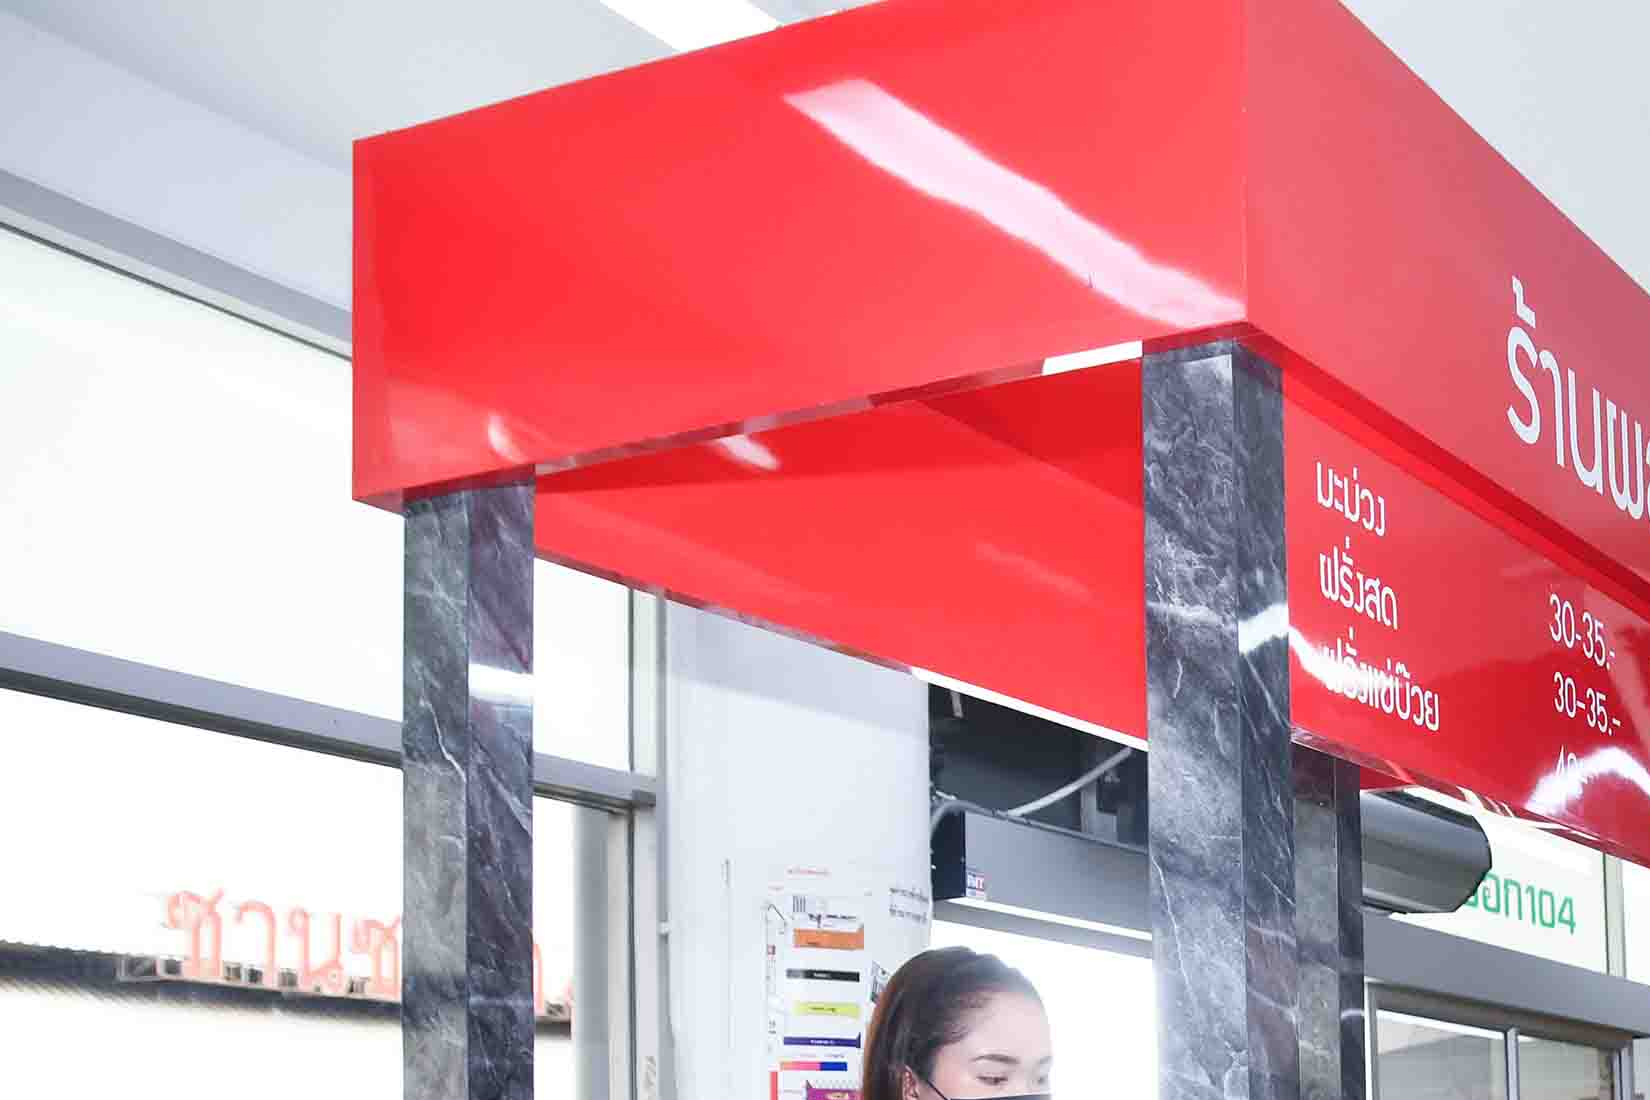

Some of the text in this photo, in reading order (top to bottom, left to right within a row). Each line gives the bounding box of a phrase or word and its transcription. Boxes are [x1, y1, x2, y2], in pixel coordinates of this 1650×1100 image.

[1316, 461, 1385, 537] มะม่วง
[1319, 535, 1398, 630] ฝรั่งสด
[1549, 592, 1616, 671] 30-35.-
[1553, 671, 1621, 736] 30-35.-
